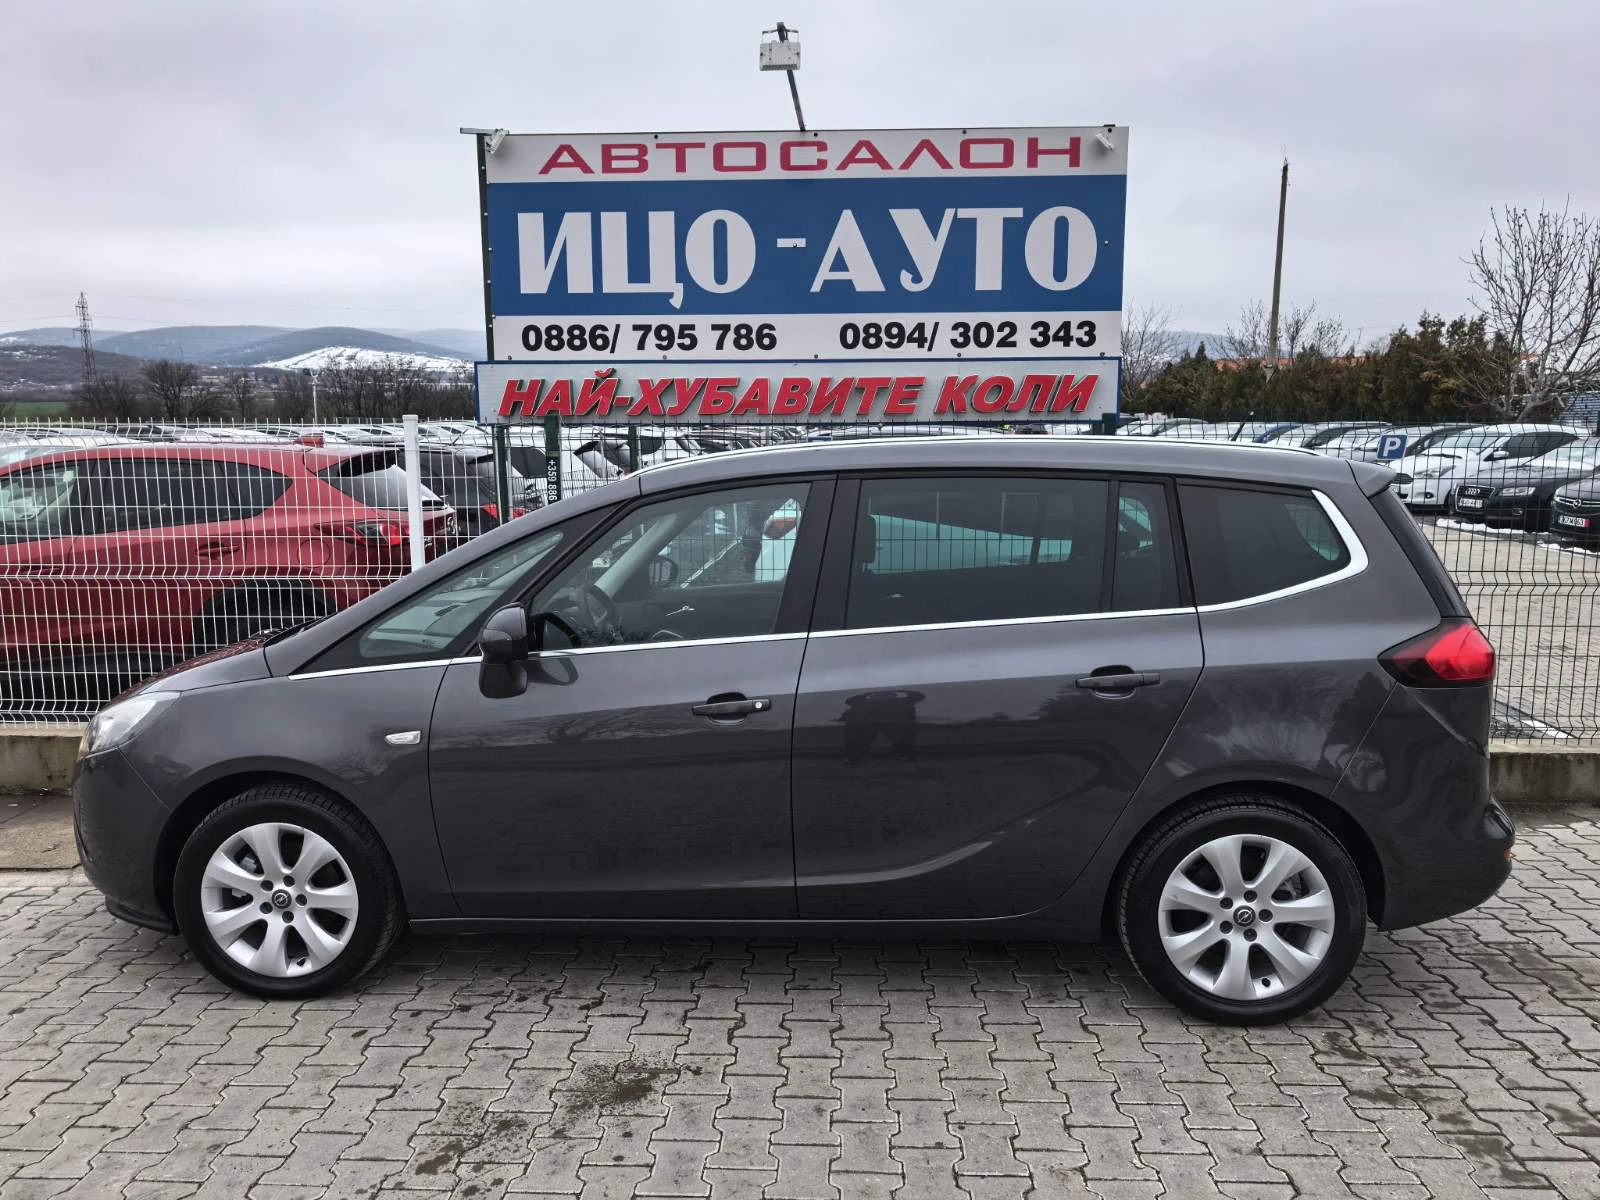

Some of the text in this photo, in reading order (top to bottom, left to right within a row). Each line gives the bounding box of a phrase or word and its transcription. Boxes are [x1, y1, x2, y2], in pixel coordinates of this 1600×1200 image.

[539, 136, 1081, 175] АВТОСАЛОН
[521, 319, 1097, 354] 0886/ 795 786 0894/ 302 343
[498, 367, 1100, 417] НАЙ-ХУБАВИТЕ КОЛИ
[1383, 437, 1402, 457] P
[547, 459, 558, 501] +359 886
